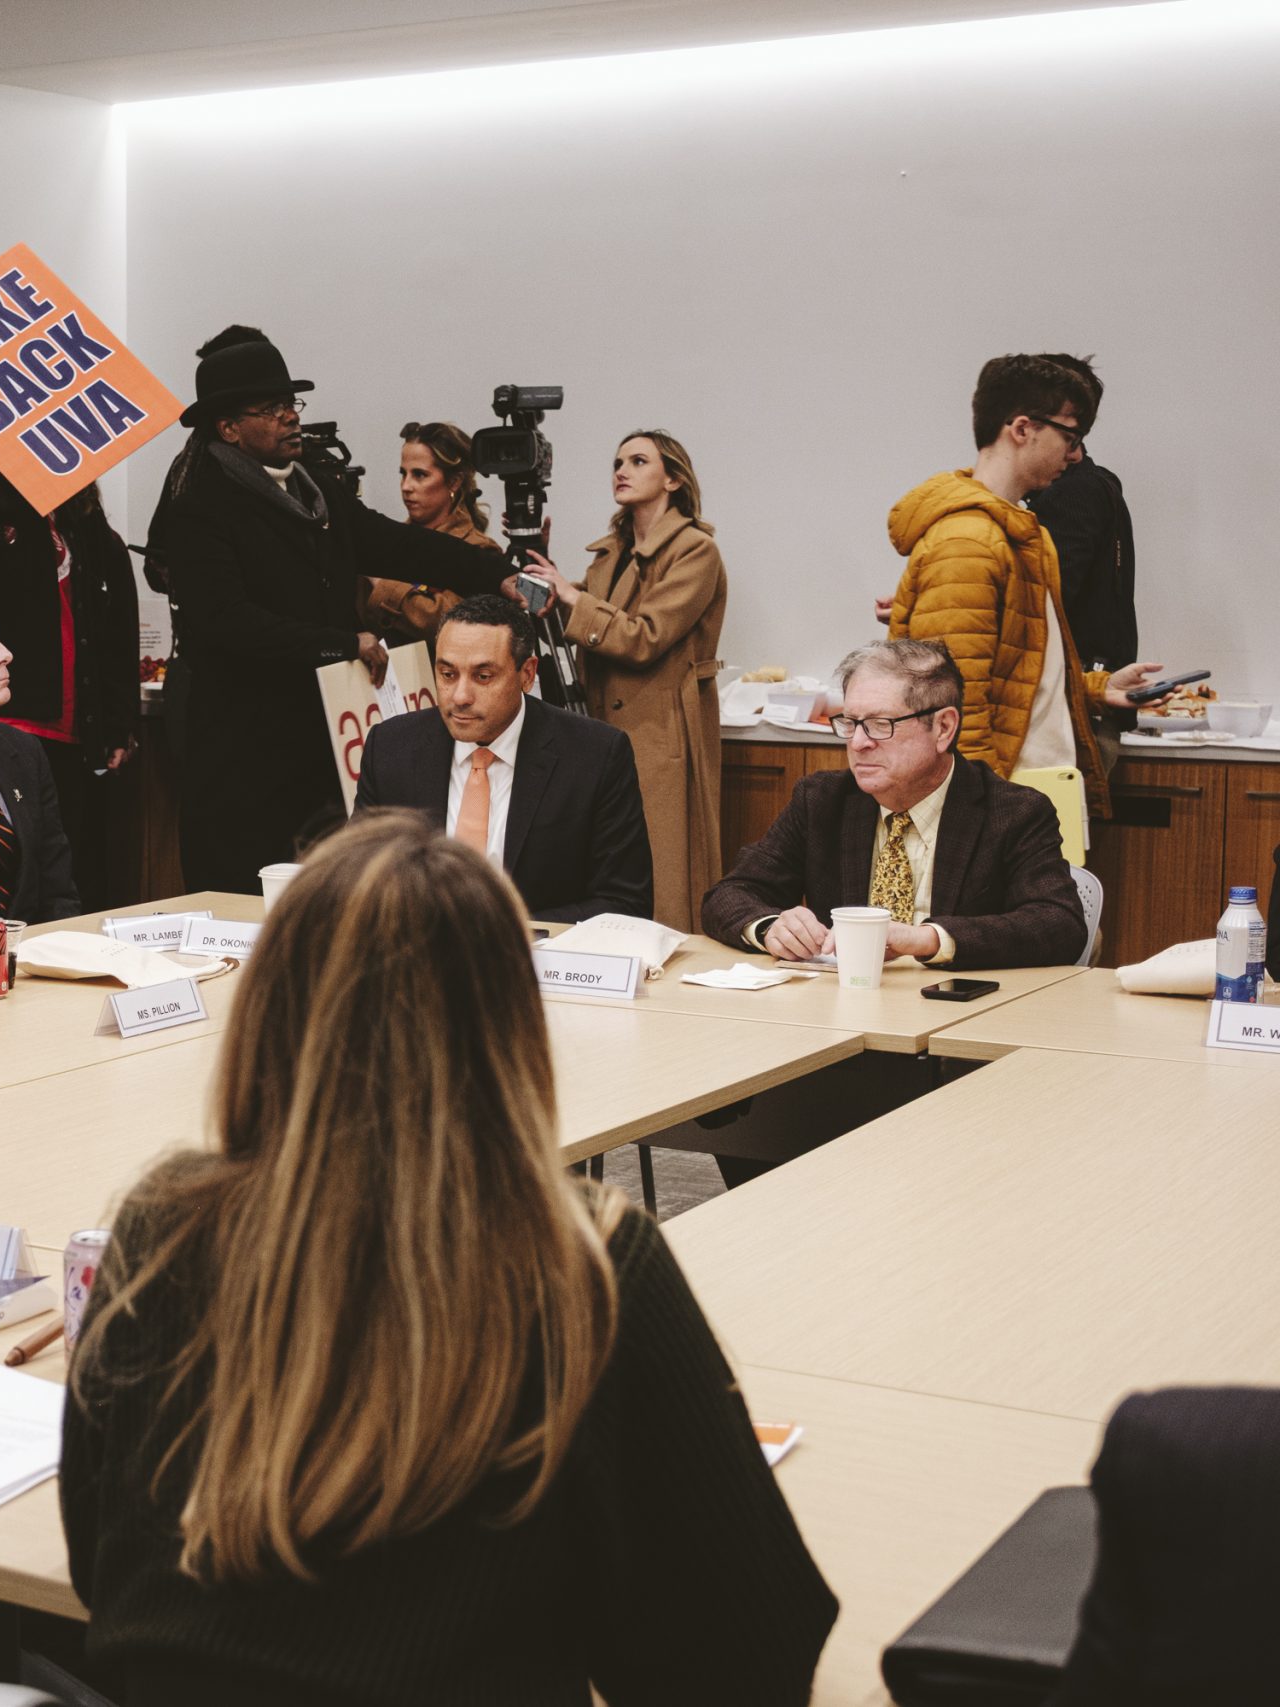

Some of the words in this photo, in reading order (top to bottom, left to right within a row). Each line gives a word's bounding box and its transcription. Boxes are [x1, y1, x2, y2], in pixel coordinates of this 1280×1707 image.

[17, 377, 148, 475] UVA
[133, 932, 151, 942] MR.
[202, 936, 217, 946] DR.
[543, 969, 562, 981] MR.
[565, 972, 602, 984] BRODY
[137, 1007, 151, 1020] MS.
[152, 1002, 181, 1016] PILLION
[1241, 1026, 1265, 1038] MR.
